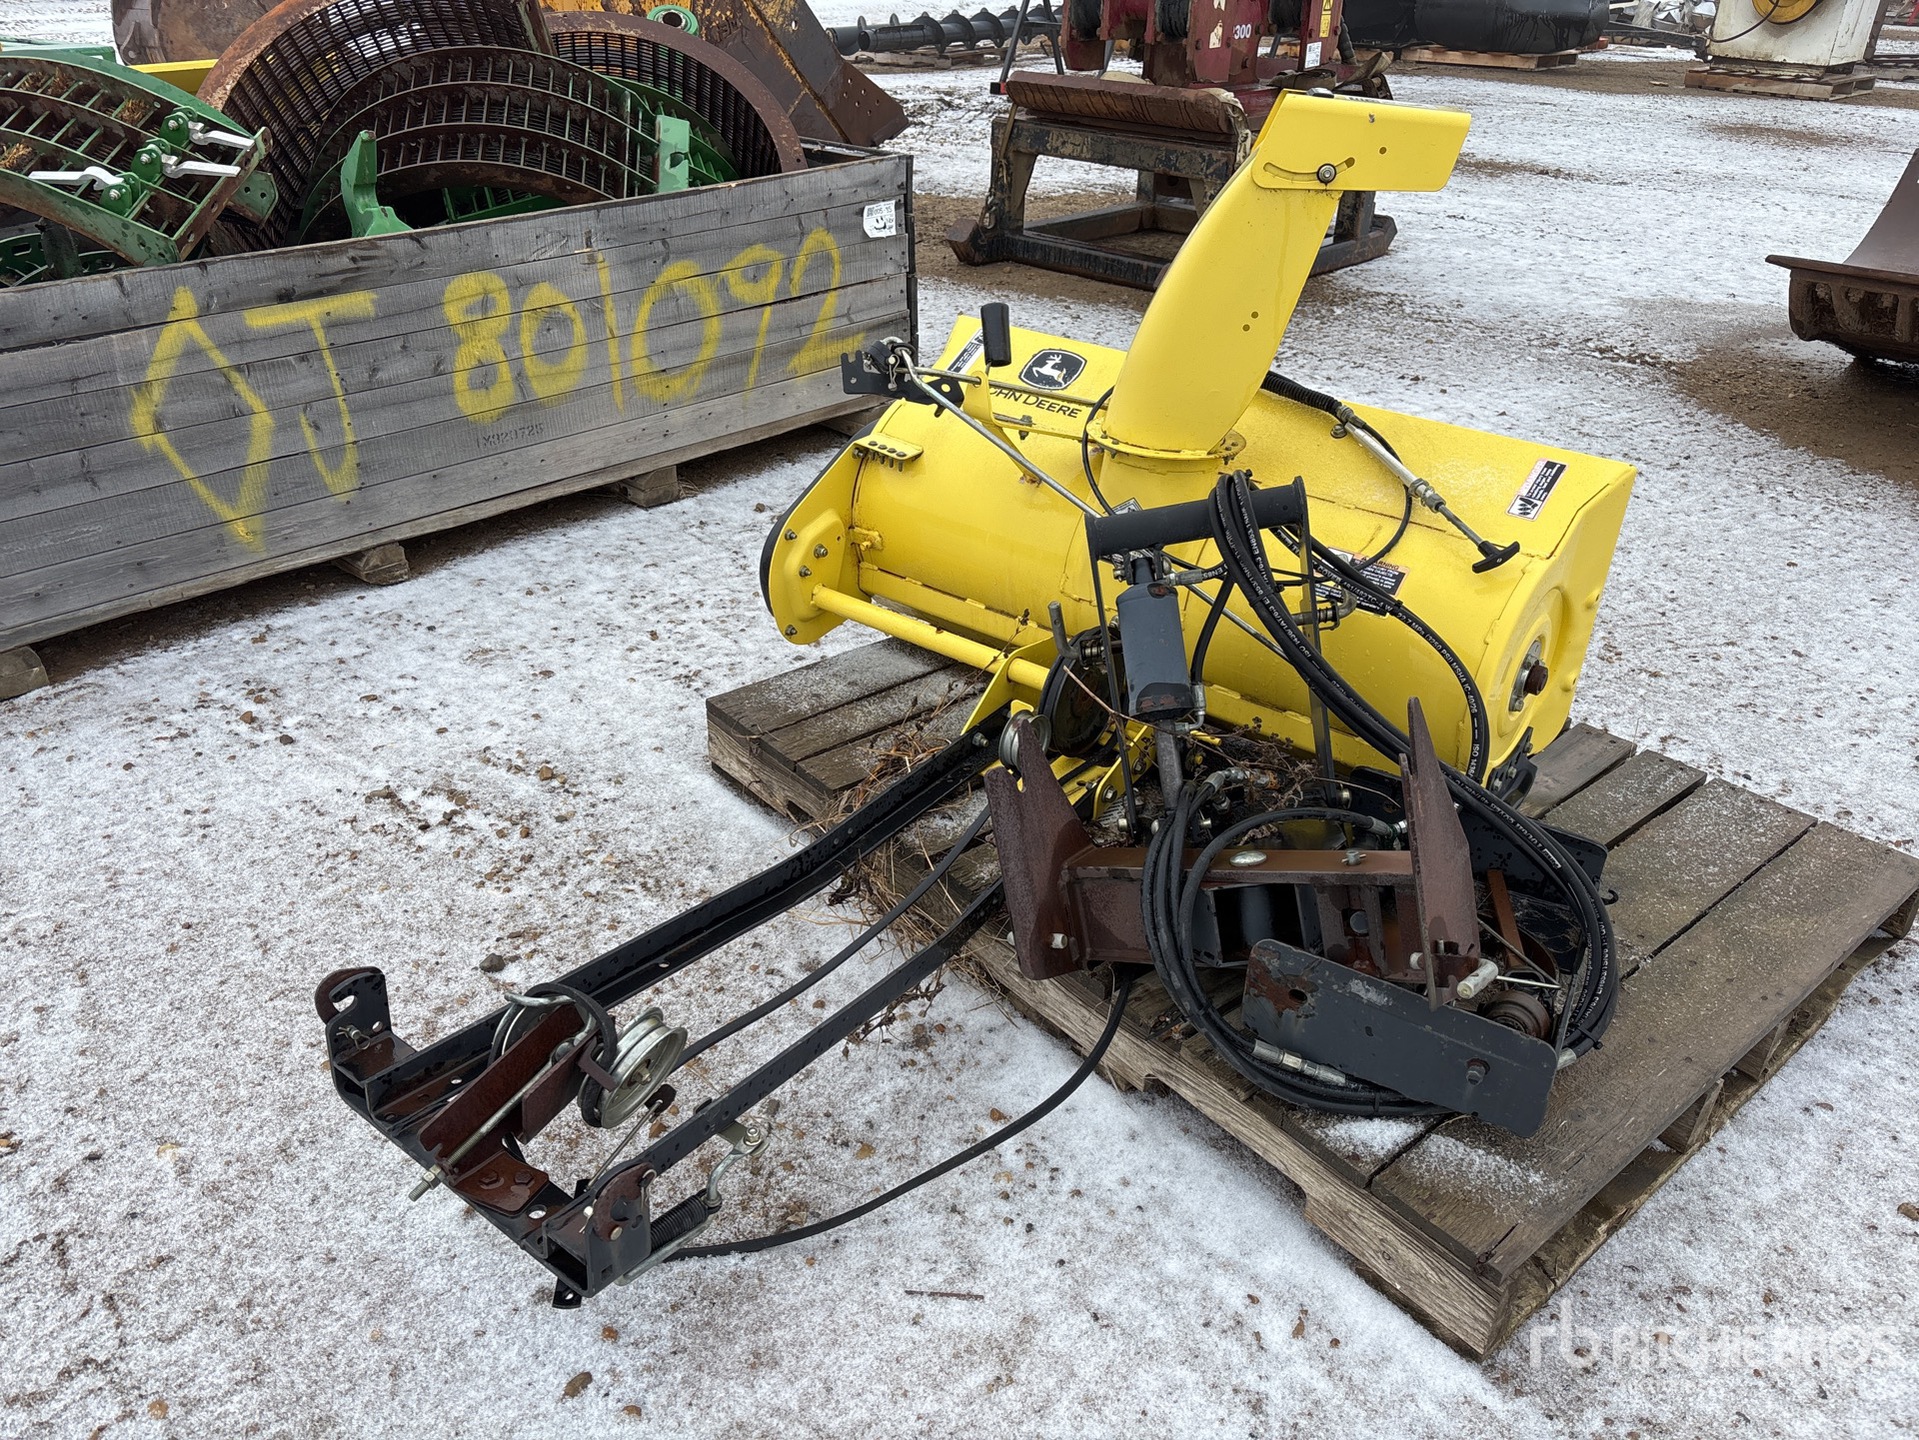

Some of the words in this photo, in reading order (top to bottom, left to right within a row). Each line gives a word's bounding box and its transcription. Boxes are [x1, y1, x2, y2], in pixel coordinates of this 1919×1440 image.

[1022, 393, 1082, 419] DEERE
[1316, 565, 1343, 583] COVER
[1451, 662, 1467, 683] MSHA
[1472, 743, 1480, 757] ISO
